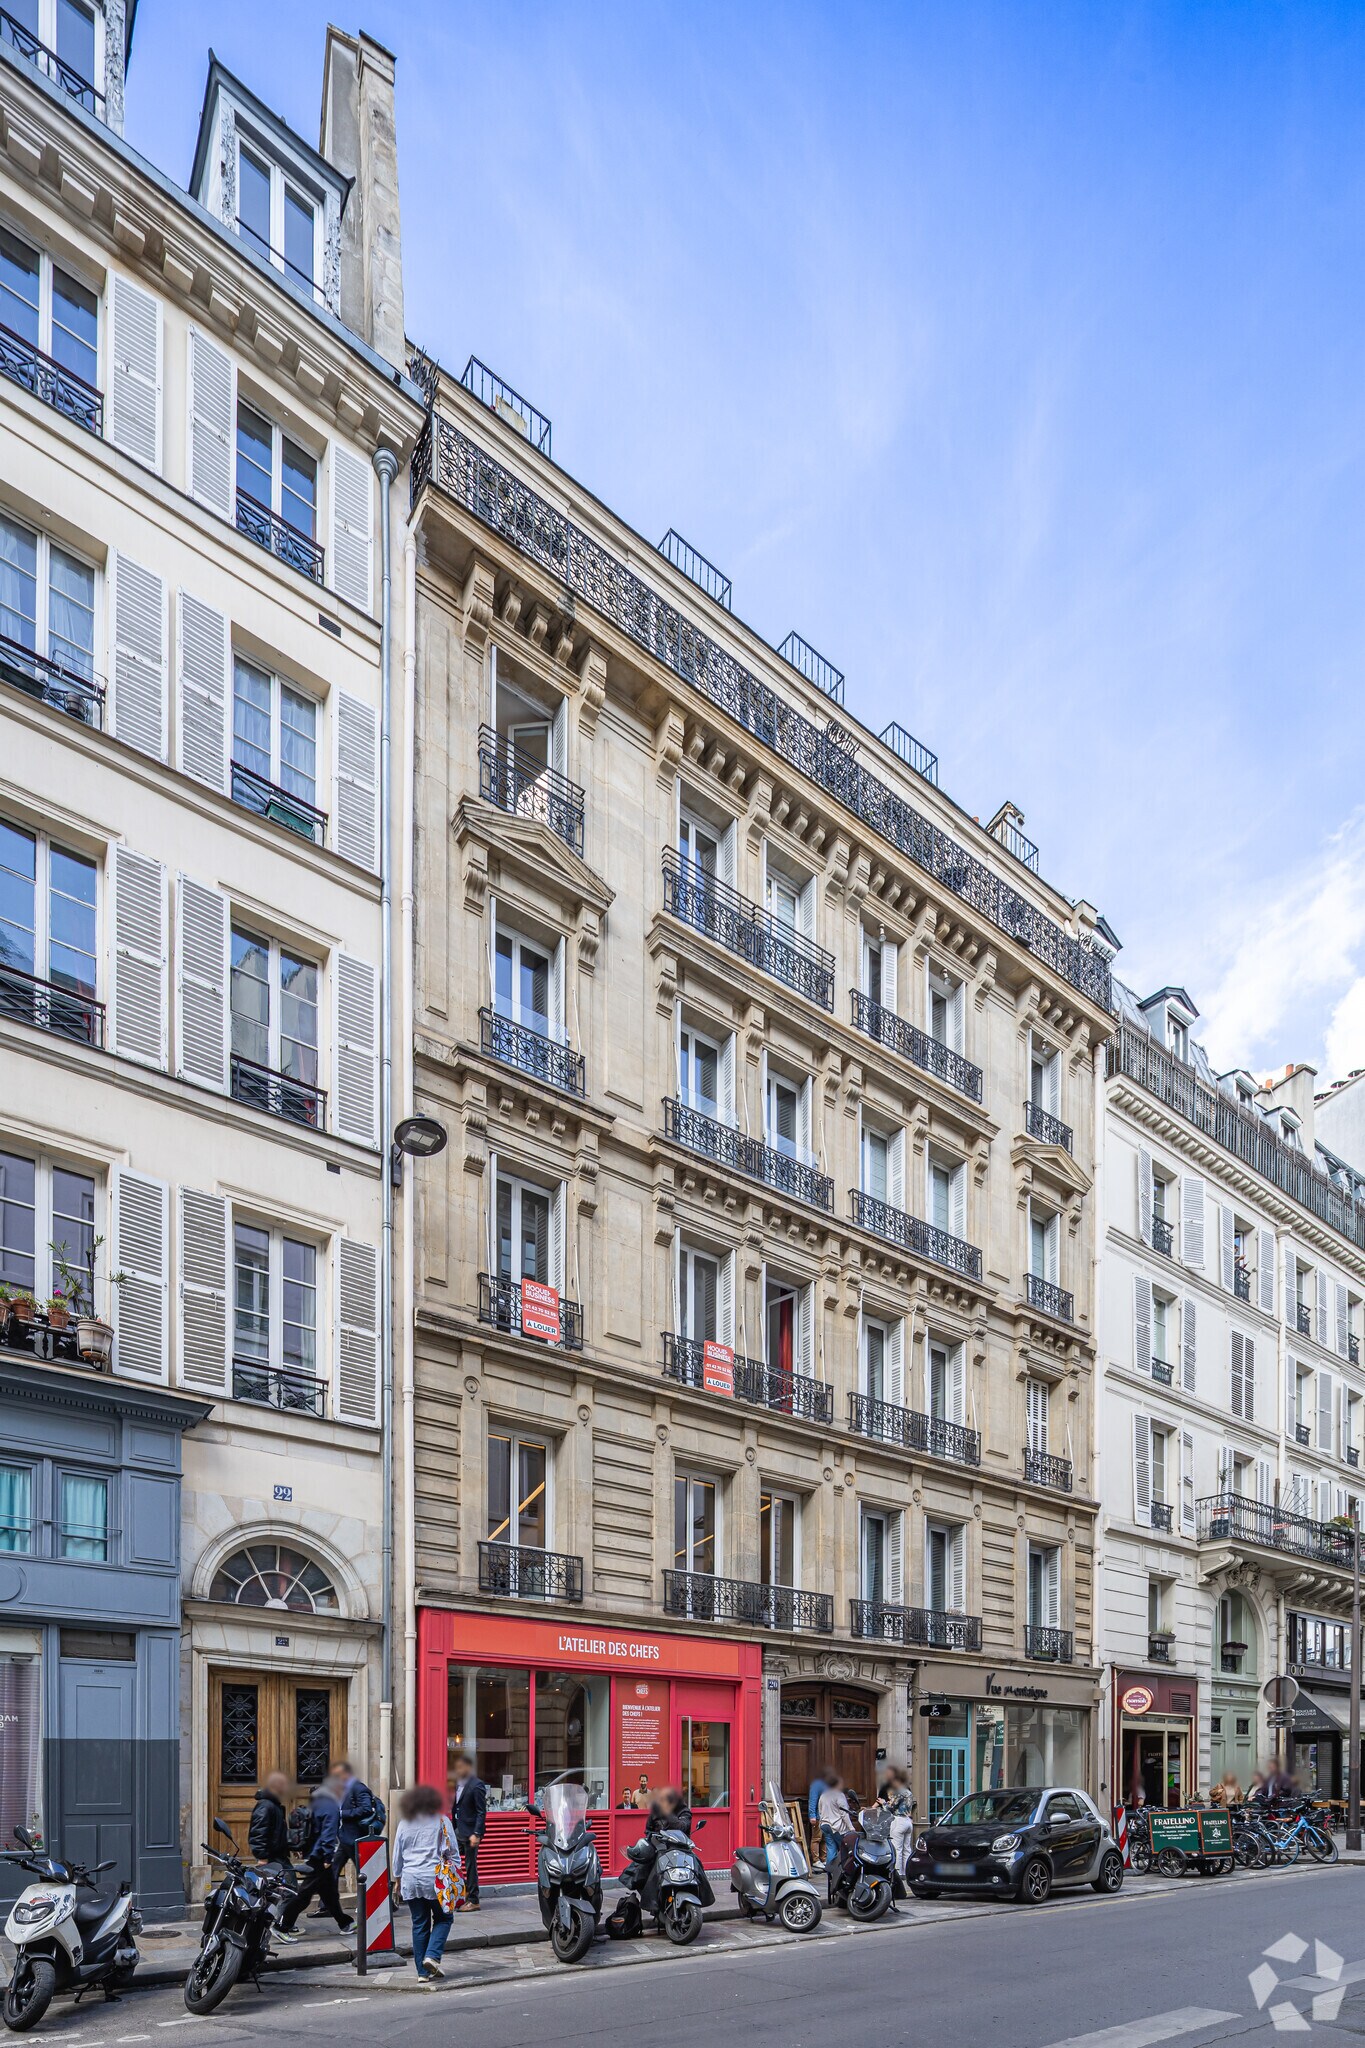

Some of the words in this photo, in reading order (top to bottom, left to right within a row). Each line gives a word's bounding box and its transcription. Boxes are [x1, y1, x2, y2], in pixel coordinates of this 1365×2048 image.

[525, 1289, 555, 1304] BUSINESS
[533, 1322, 556, 1334] LOUER
[712, 1380, 730, 1389] LOUER
[275, 1486, 292, 1500] 22
[558, 1636, 606, 1655] L'ATELIER
[608, 1641, 628, 1656] DES
[629, 1644, 660, 1660] CHEFS
[986, 1672, 1002, 1696] Vue
[1154, 1817, 1195, 1825] FRATELLINO
